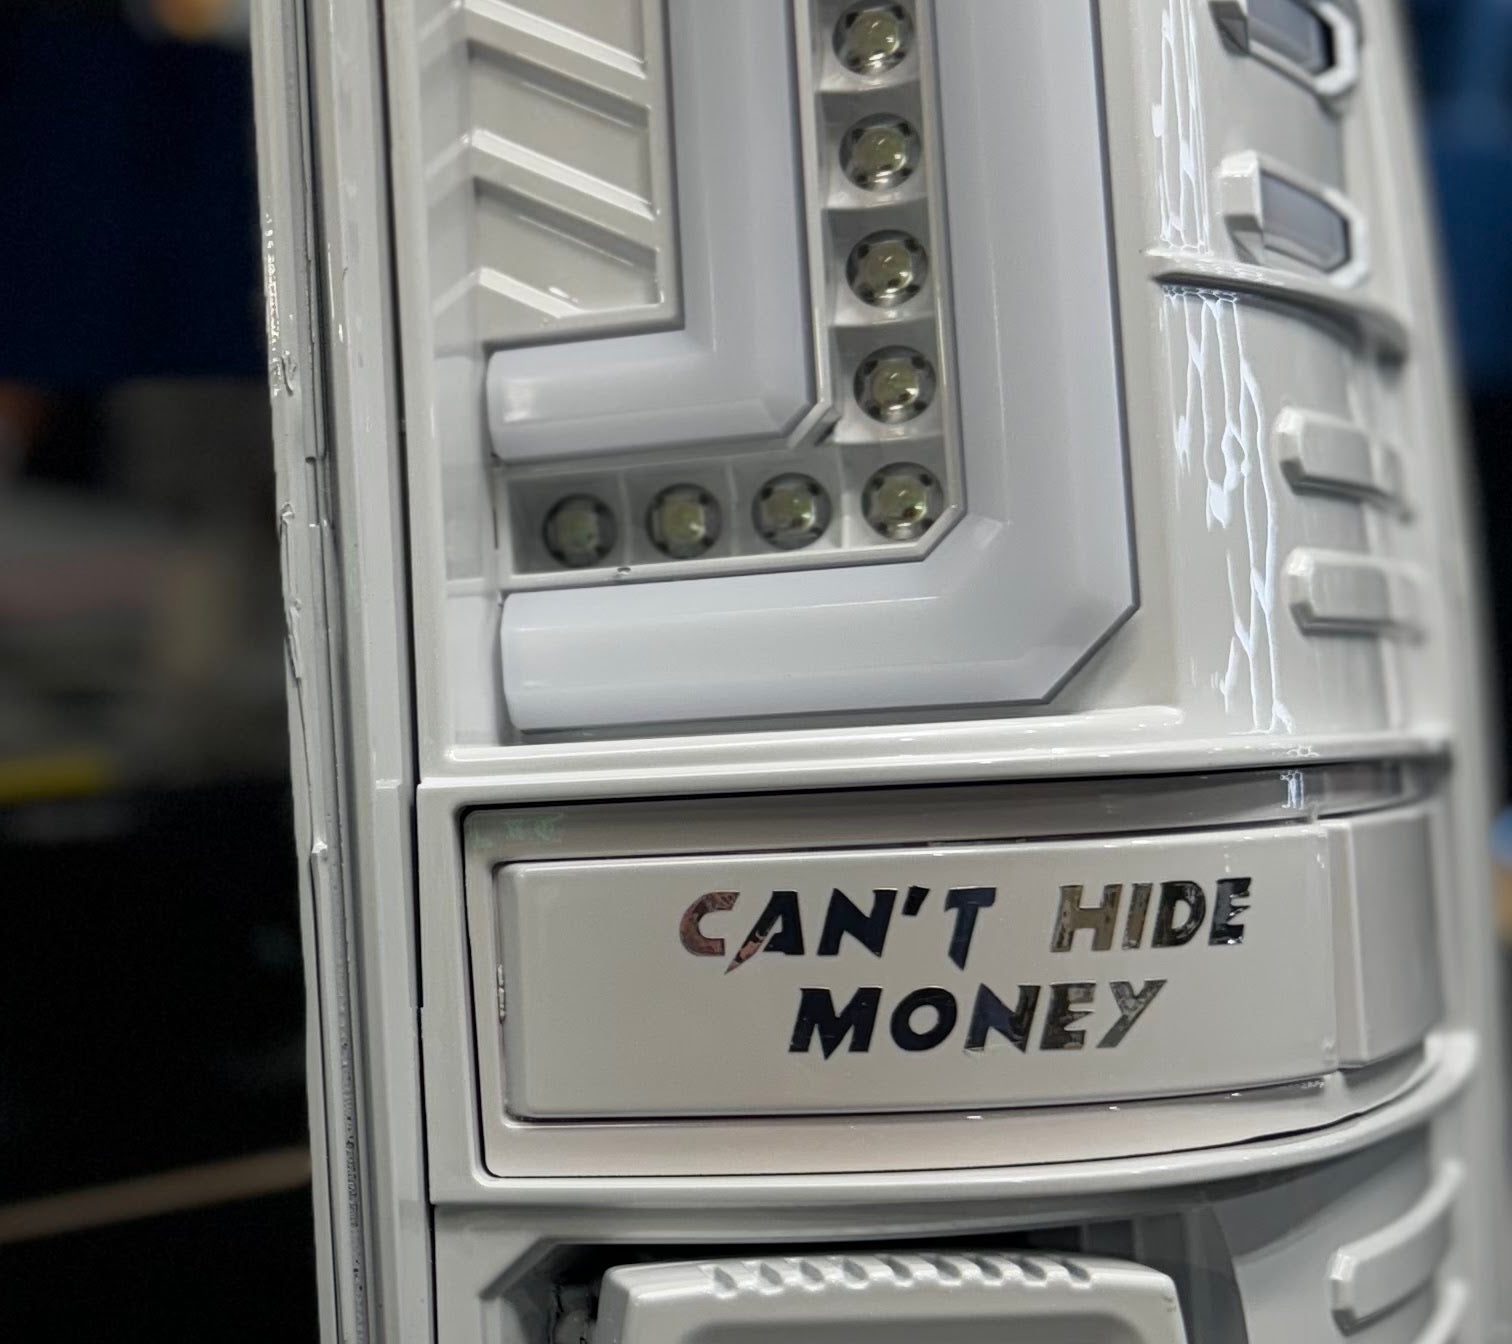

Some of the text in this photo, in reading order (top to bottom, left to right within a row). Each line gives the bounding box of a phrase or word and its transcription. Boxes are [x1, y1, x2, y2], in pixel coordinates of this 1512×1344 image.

[679, 877, 1251, 975] CAN'T HIDE
[788, 979, 1167, 1060] MONEY
